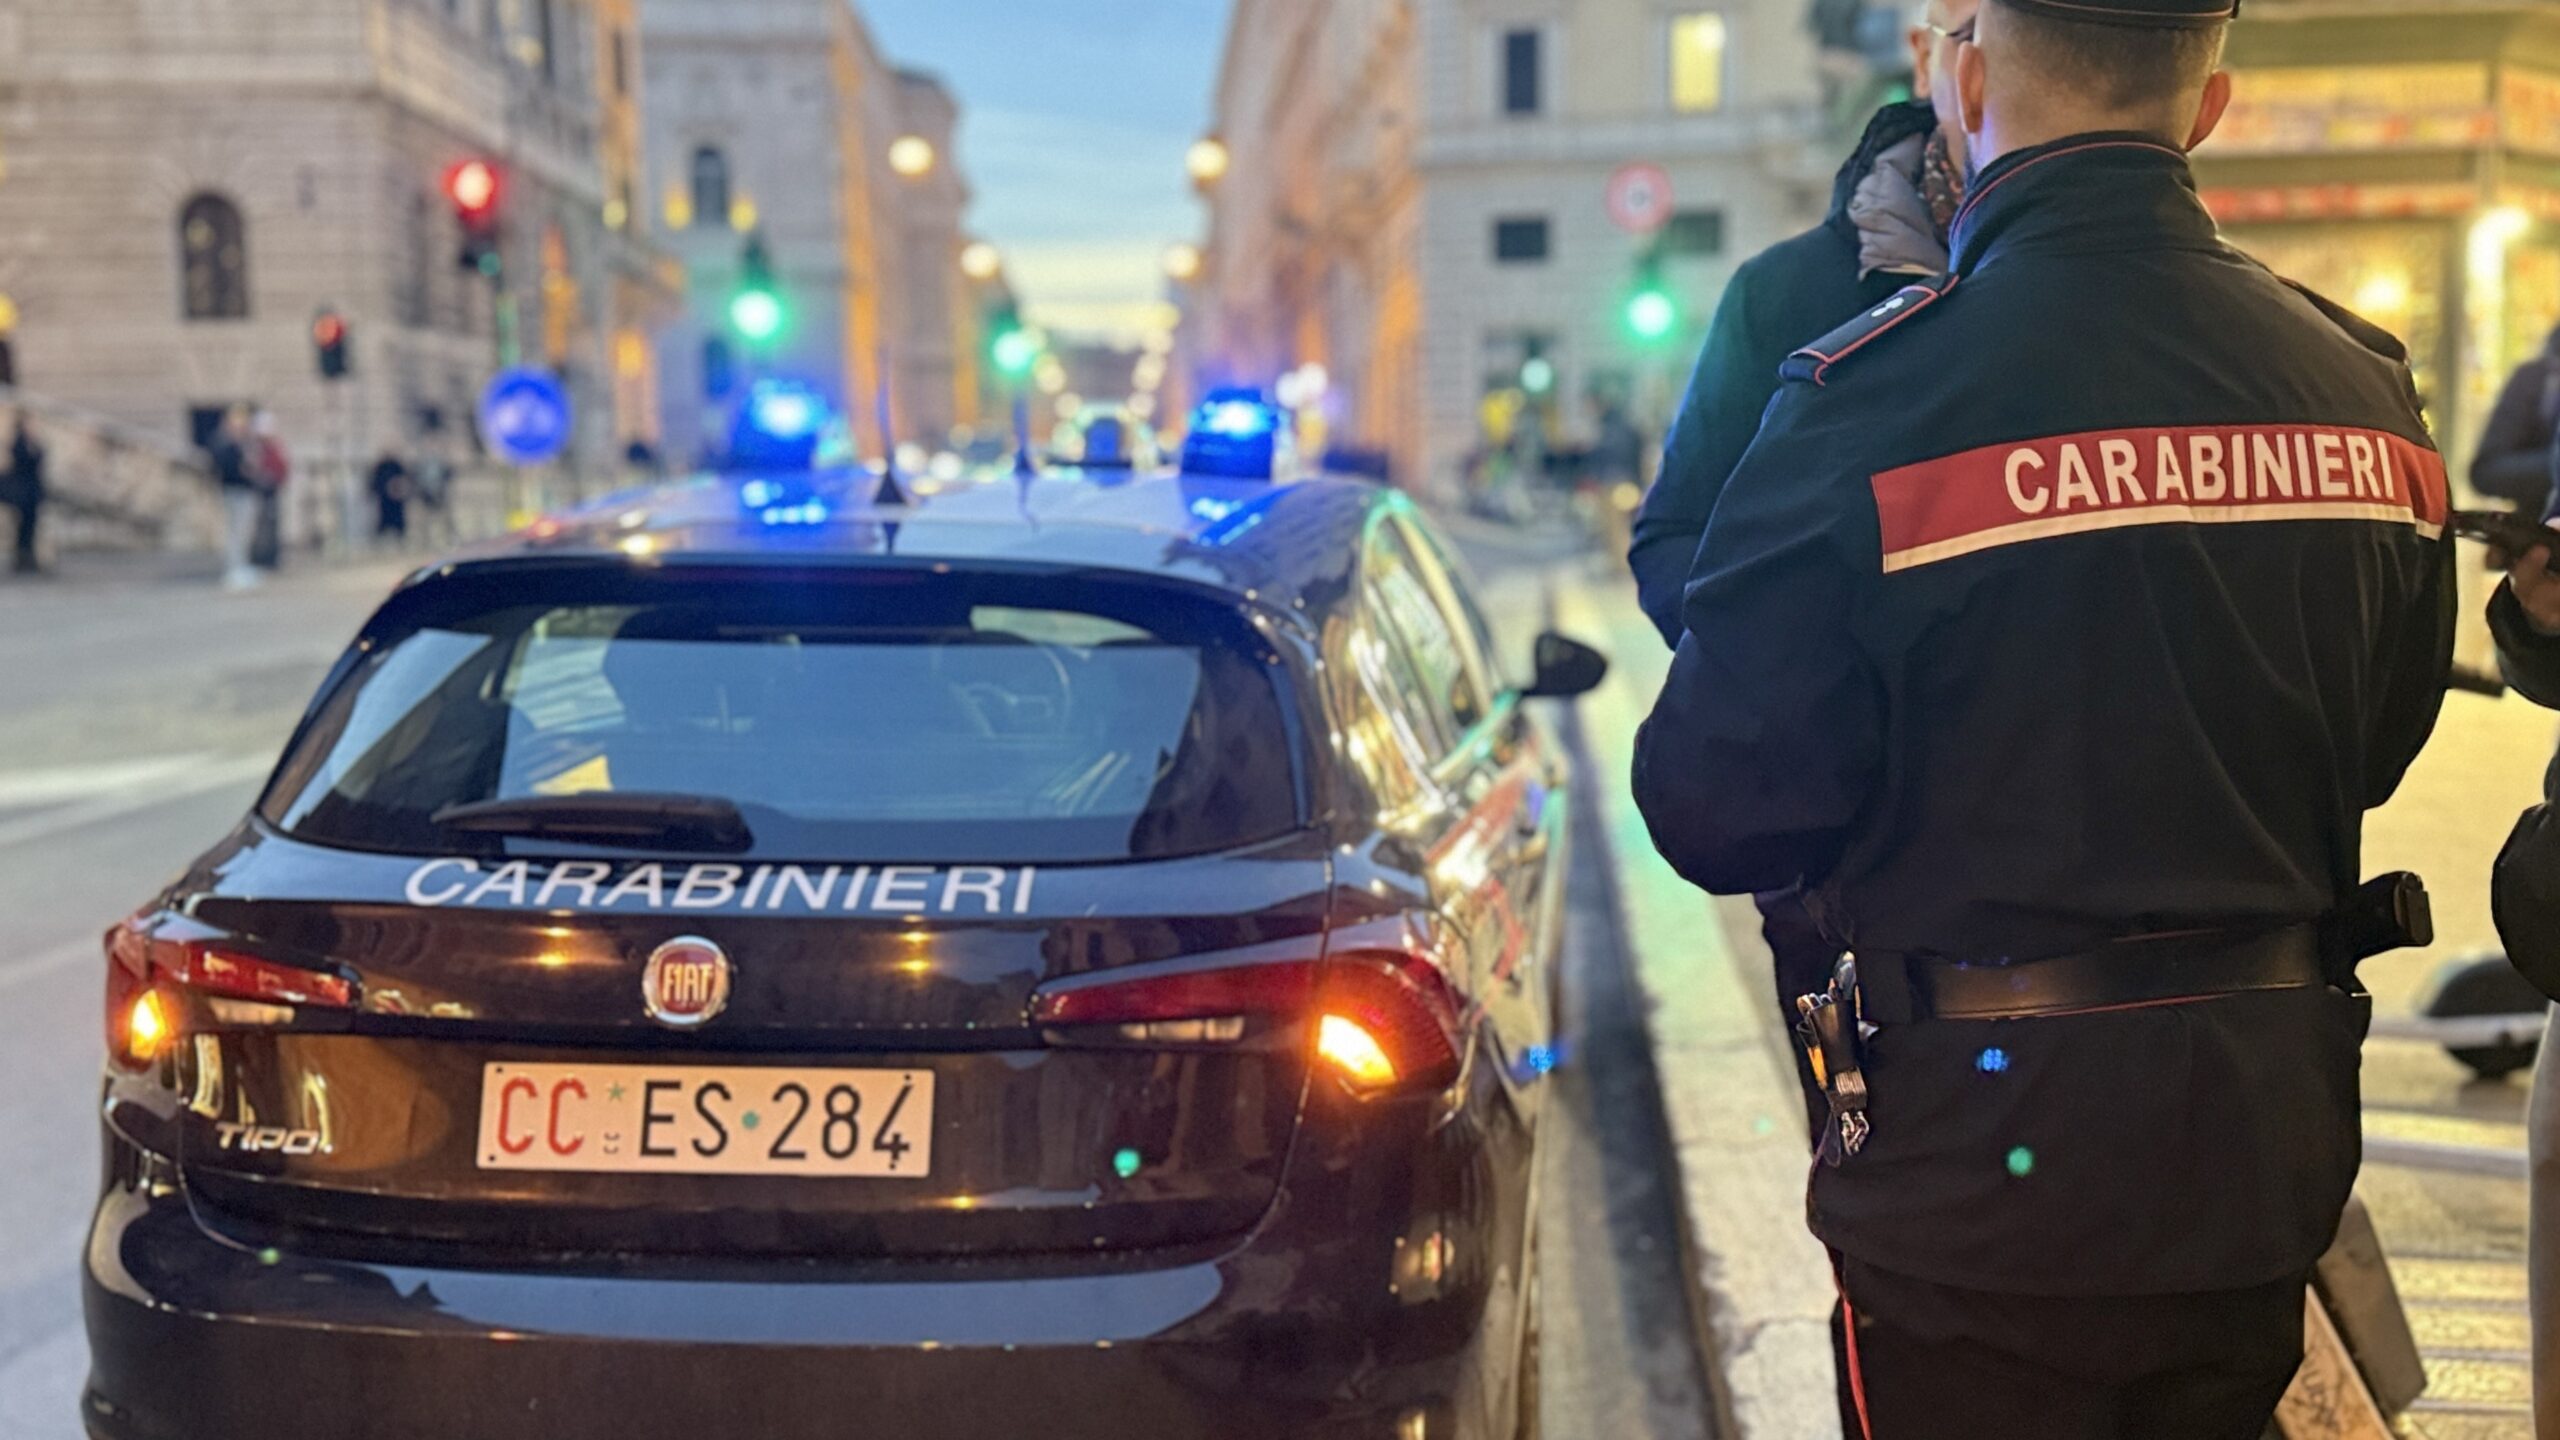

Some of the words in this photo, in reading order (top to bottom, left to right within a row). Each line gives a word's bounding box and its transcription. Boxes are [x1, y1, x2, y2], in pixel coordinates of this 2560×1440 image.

[2004, 432, 2395, 514] CARABINIERI
[405, 857, 1036, 914] CARABINIERI
[663, 963, 714, 1003] FIAT
[215, 1121, 319, 1154] TIPO
[498, 1077, 588, 1156] CC
[639, 1080, 732, 1158] ES
[768, 1083, 913, 1163] 284
